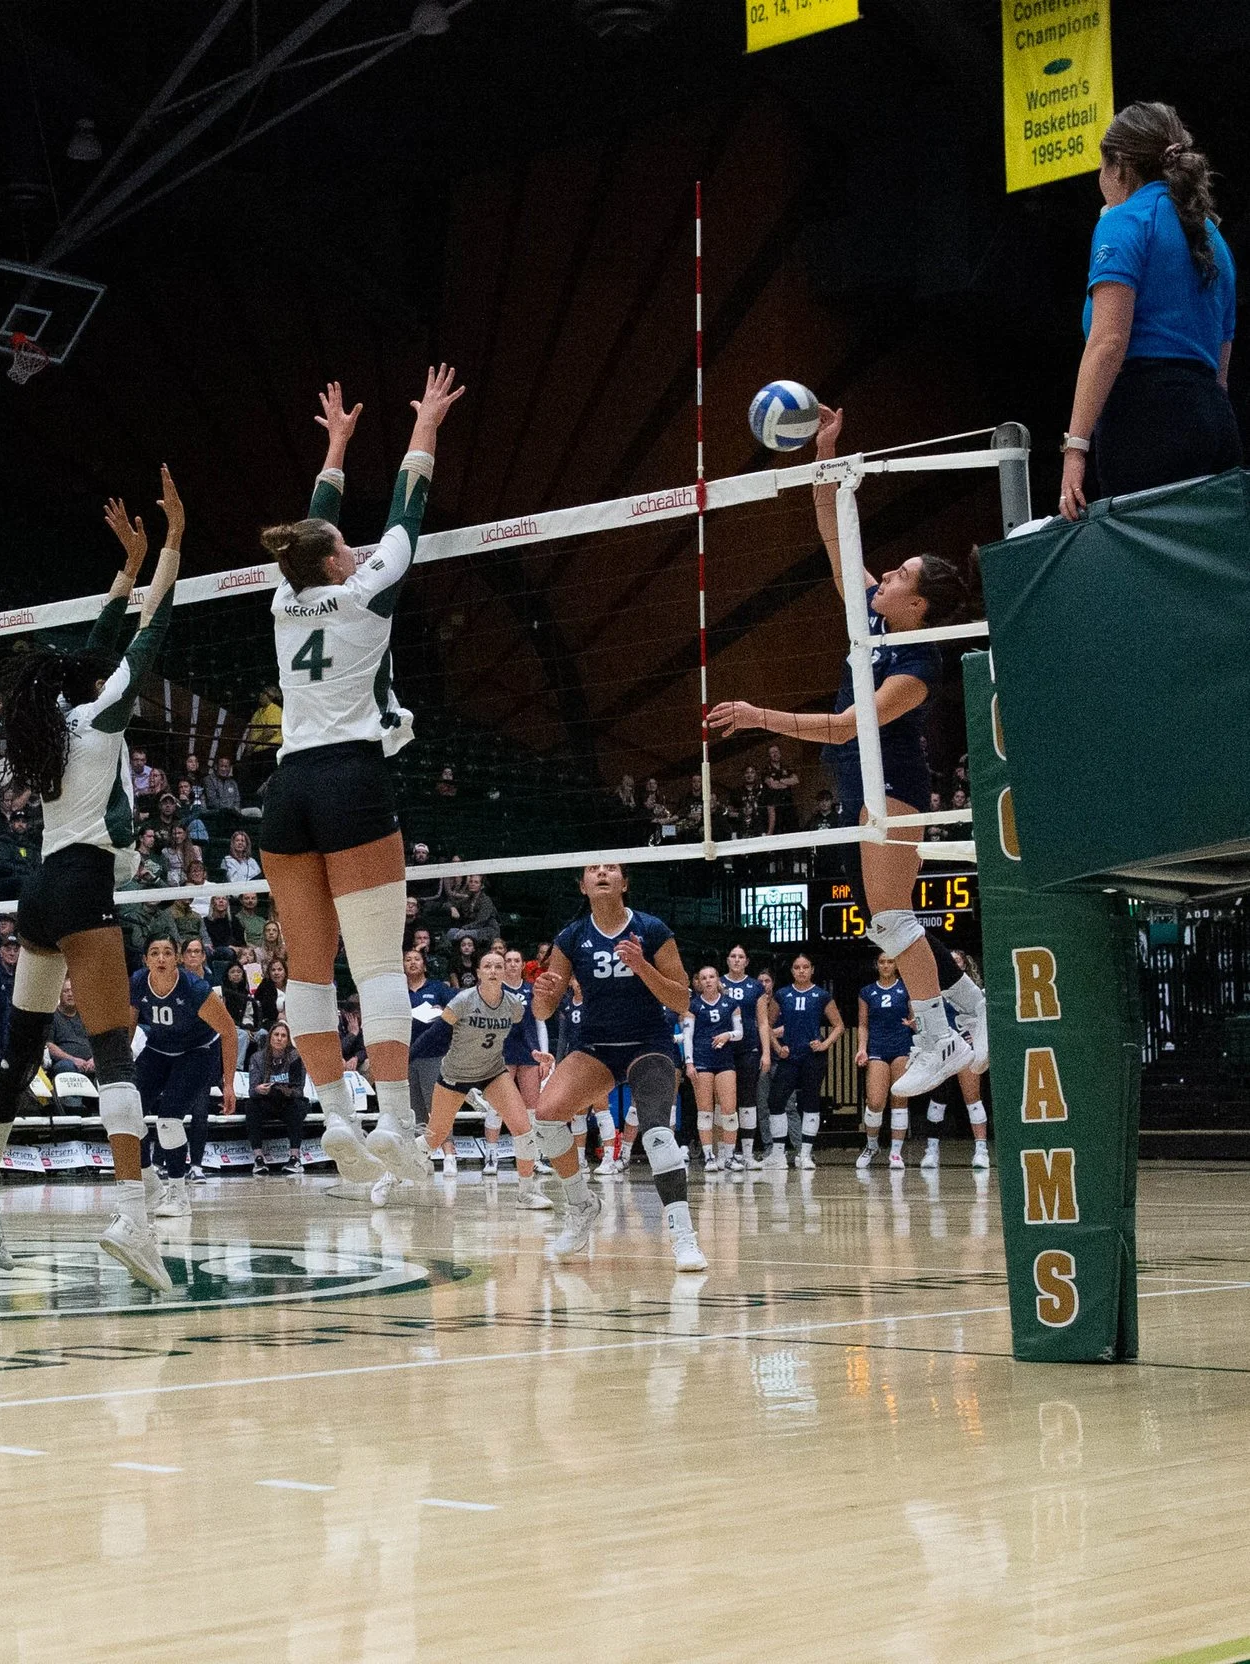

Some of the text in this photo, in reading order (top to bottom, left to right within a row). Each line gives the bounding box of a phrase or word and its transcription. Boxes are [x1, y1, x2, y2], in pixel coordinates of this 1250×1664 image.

[750, 4, 768, 24] 02,
[1013, 0, 1082, 22] Confer
[1015, 12, 1100, 50] Champions
[1026, 78, 1090, 111] Women's
[1024, 103, 1098, 140] Basketball
[1032, 135, 1084, 167] 1995-96
[826, 461, 848, 469] Senoh
[631, 488, 692, 517] uchealth
[481, 517, 538, 543] uchealth
[217, 568, 266, 591] uchealth
[284, 597, 339, 617] HERMAN
[291, 628, 333, 682] 4
[842, 906, 865, 935] 15
[918, 913, 955, 931] ERIOD 2
[593, 951, 635, 978] 32
[795, 997, 806, 1011] 11
[881, 995, 892, 1008] 2
[152, 1006, 173, 1026] 10
[571, 1010, 582, 1024] 8
[710, 1010, 720, 1024] 5
[481, 1033, 496, 1049] 3
[1012, 947, 1079, 1328] RAMS
[3, 1149, 37, 1160] edersen
